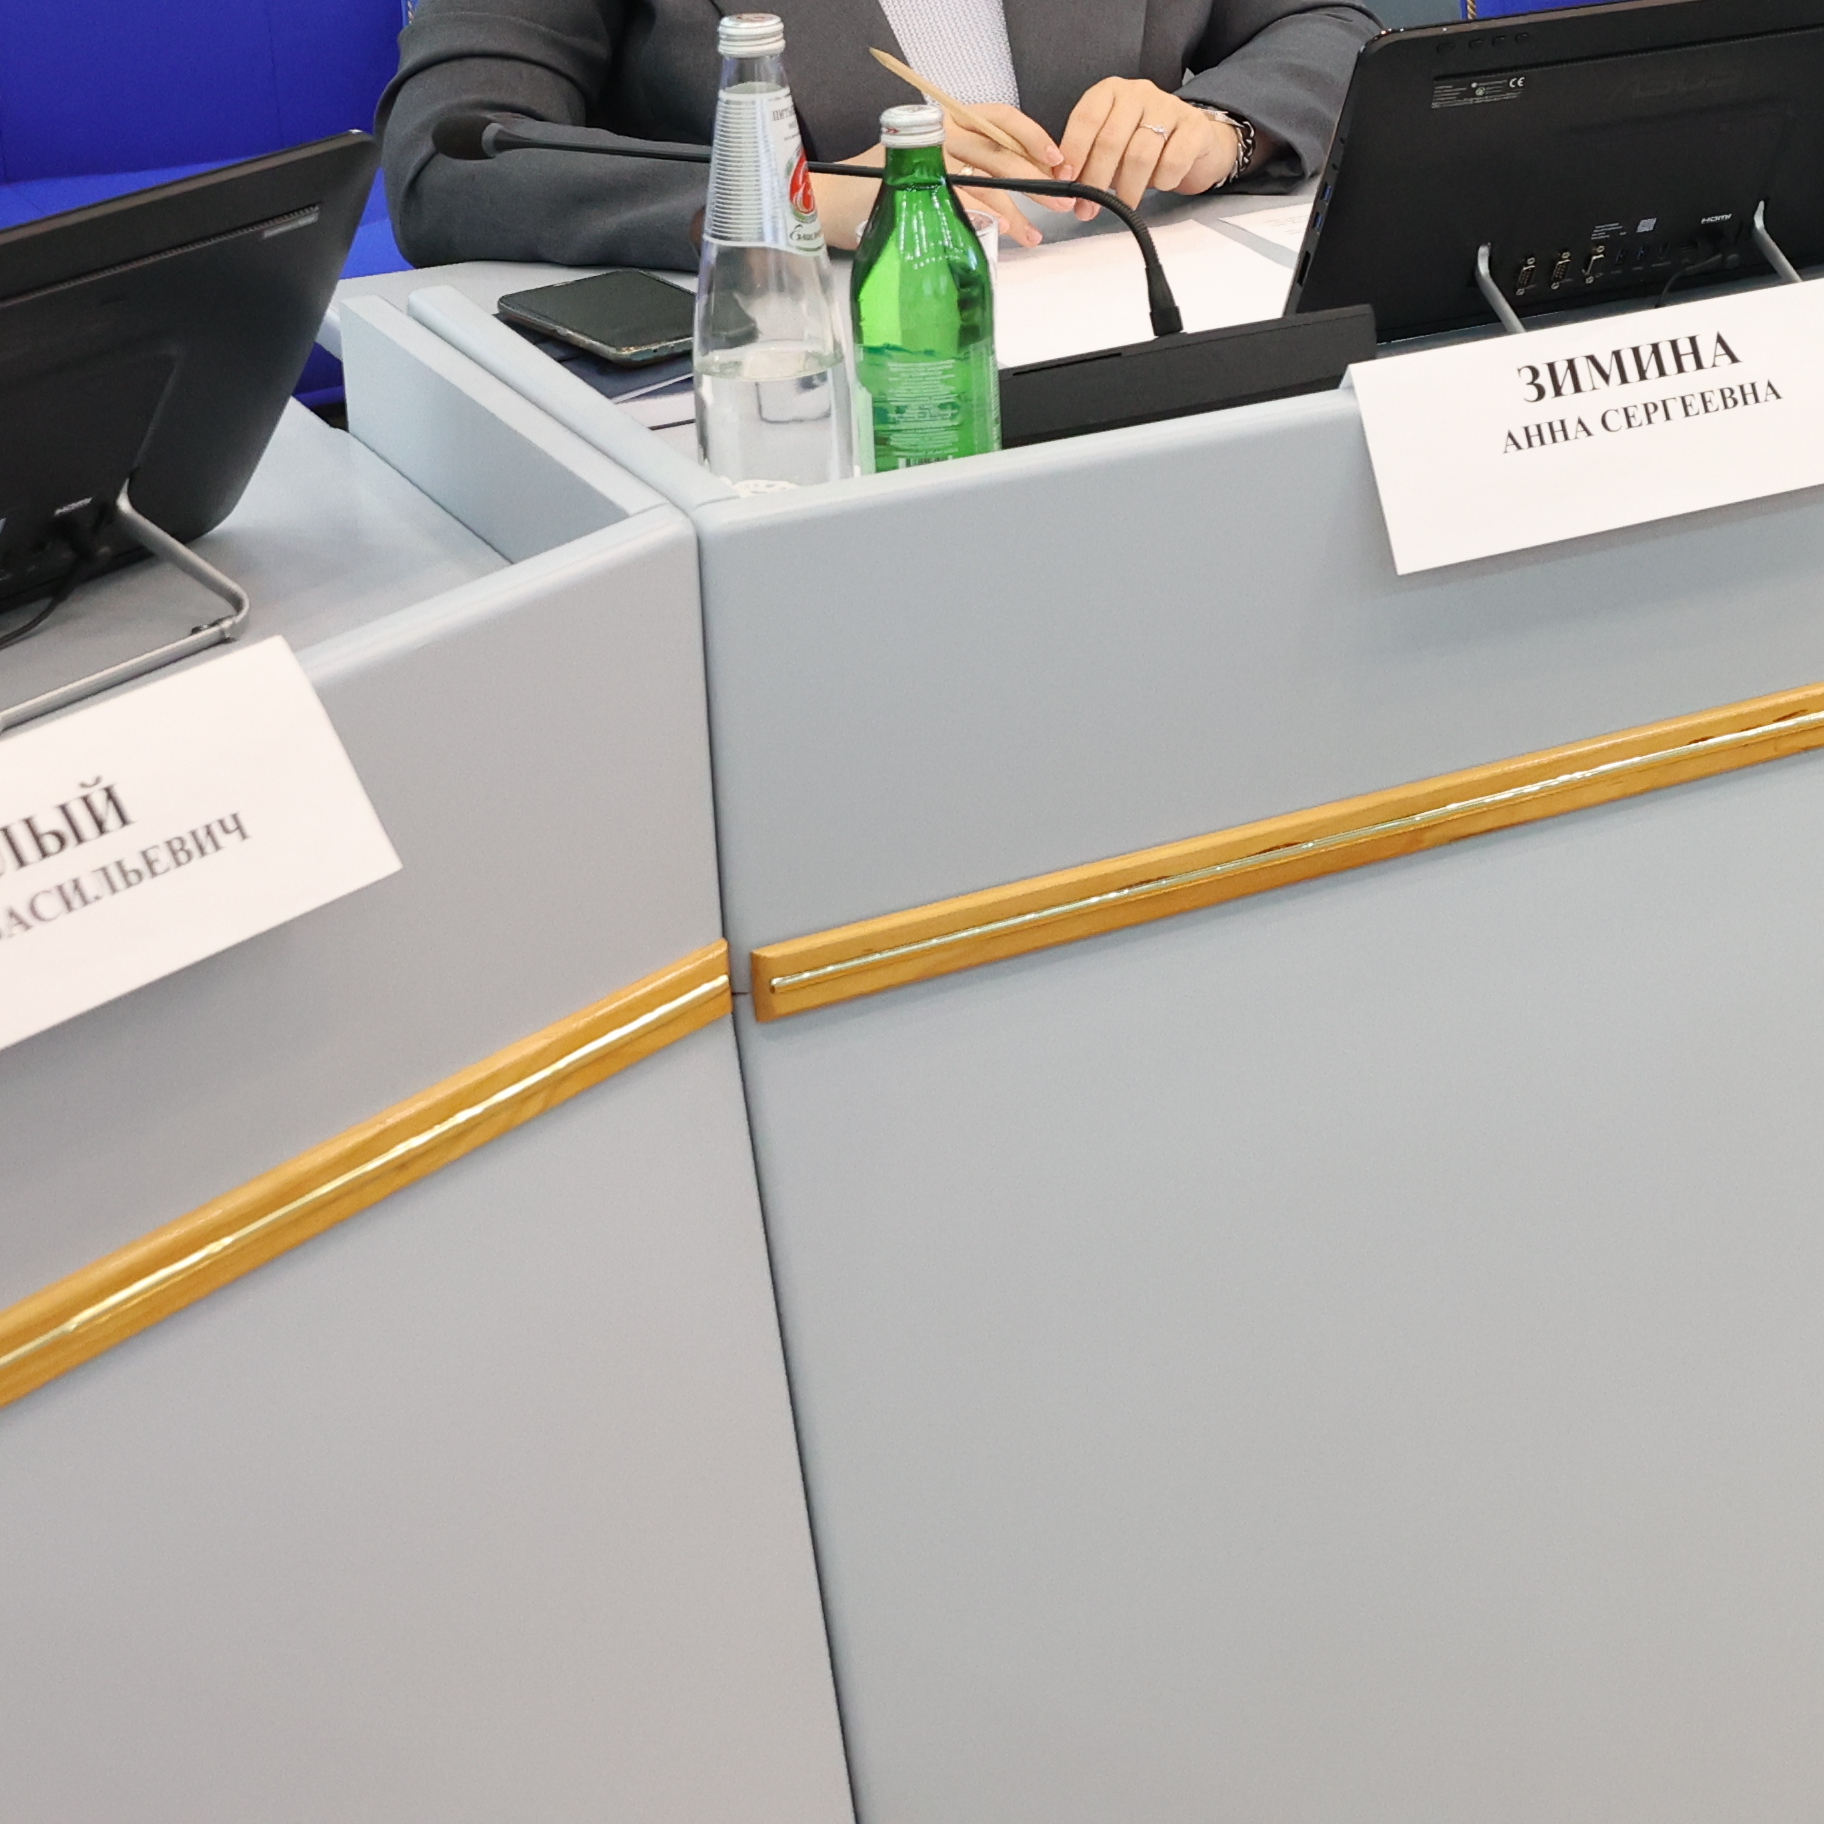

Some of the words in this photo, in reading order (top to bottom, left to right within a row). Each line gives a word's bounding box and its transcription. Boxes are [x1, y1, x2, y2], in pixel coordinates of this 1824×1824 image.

[1517, 331, 1743, 404] ЗИМИНА
[1503, 416, 1595, 454] АННА
[1601, 379, 1782, 434] СЕРГЕЕВНА
